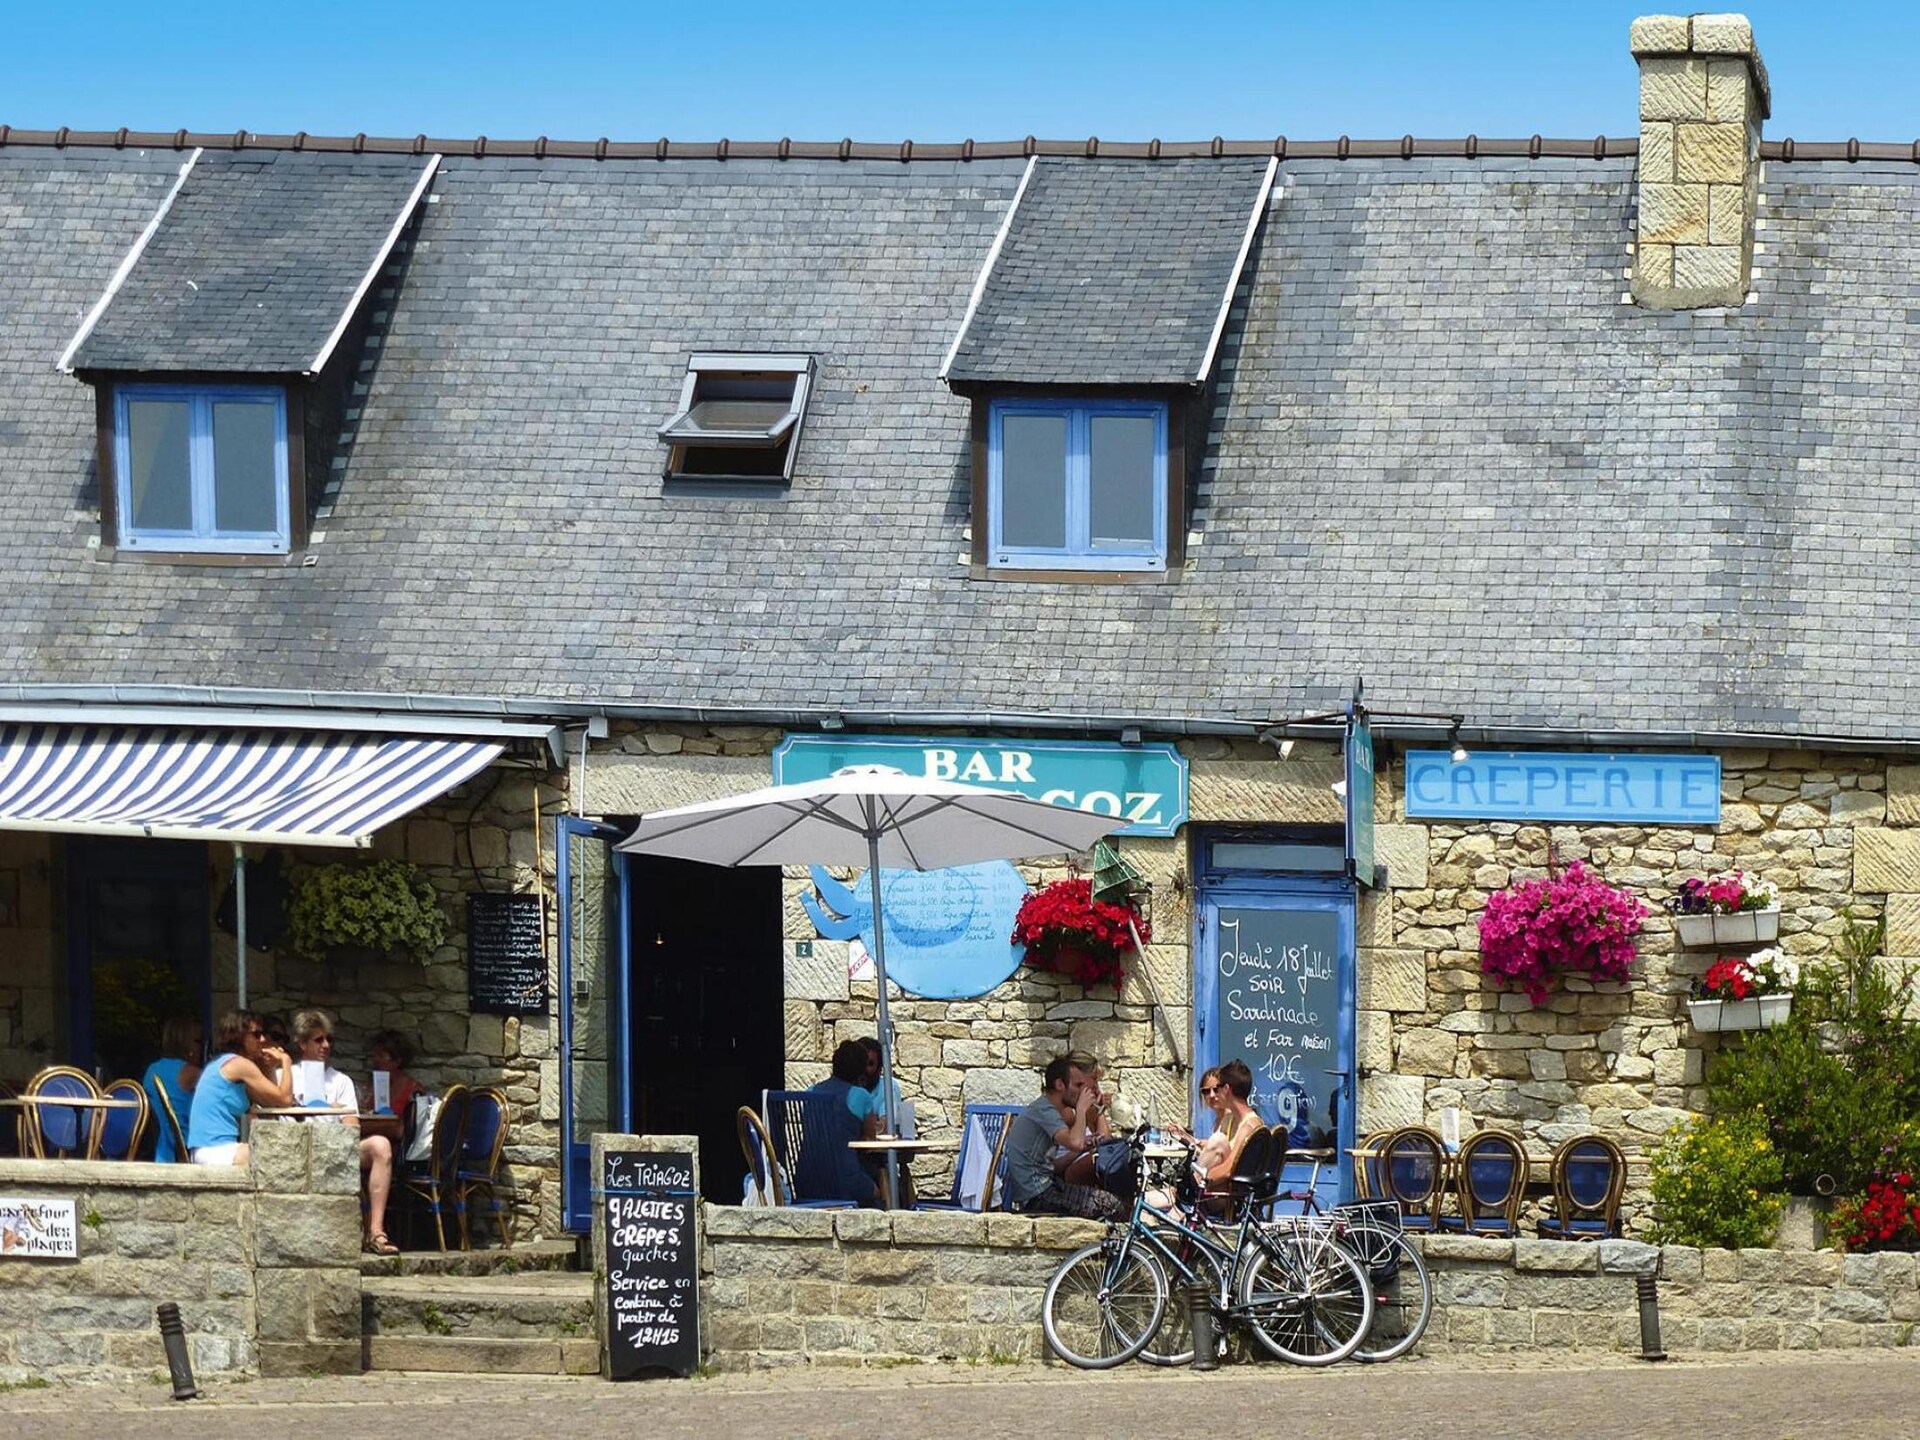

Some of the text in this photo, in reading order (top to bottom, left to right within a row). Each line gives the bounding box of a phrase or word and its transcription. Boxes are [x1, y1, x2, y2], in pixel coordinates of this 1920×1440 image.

[923, 749, 1036, 783] BAR
[1412, 763, 1715, 810] CREPERIE
[1220, 918, 1333, 995] Jeudi 18 Juillet
[1227, 989, 1319, 1026] Sardinade
[1244, 1028, 1259, 1049] et
[1266, 1028, 1295, 1048] Far
[1259, 1053, 1305, 1084] 10€
[606, 1156, 633, 1188] Les
[46, 1222, 70, 1238] des
[622, 1245, 678, 1271] quiches
[610, 1269, 691, 1292] Service en
[617, 1308, 677, 1332] partir de
[628, 1326, 680, 1349] 12H15
